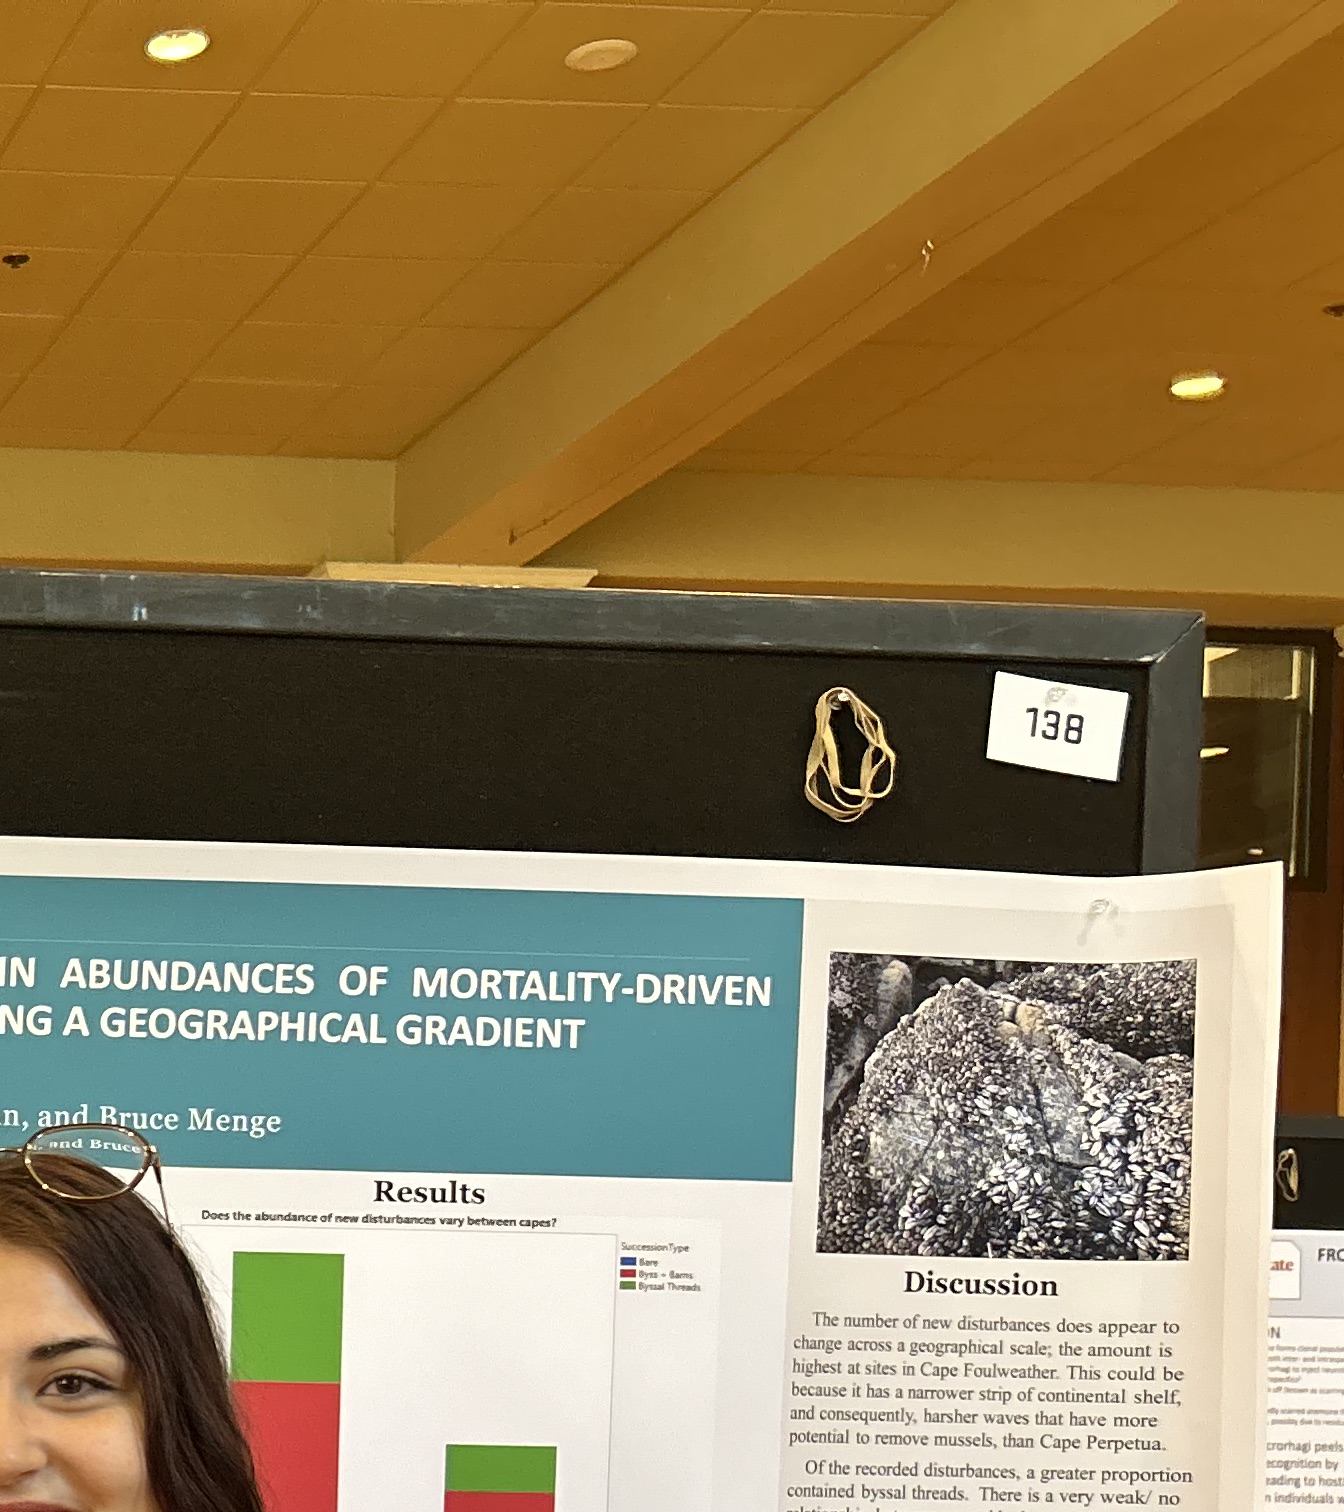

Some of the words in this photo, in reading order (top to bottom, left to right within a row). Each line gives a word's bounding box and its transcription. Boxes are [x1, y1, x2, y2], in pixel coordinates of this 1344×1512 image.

[1026, 707, 1084, 745] 138
[59, 958, 314, 995] ABUNDANCES
[339, 965, 388, 996] OF
[412, 967, 771, 1006] MORTALITY-DRIVEN
[62, 1005, 90, 1036] A
[100, 1006, 387, 1044] GEOGRAPHICAL
[396, 1014, 586, 1048] GRADIENT
[37, 1103, 88, 1127] and
[99, 1105, 179, 1130] Bruce
[187, 1107, 281, 1139] Menge
[373, 1180, 485, 1204] Results
[904, 1270, 1058, 1296] Discussion
[793, 1334, 842, 1354] change
[847, 1339, 892, 1352] across
[896, 1341, 905, 1352] a
[909, 1338, 1003, 1358] geographical
[1009, 1340, 1052, 1358] scale;
[1058, 1340, 1083, 1356] the
[1087, 1345, 1152, 1357] amount
[1159, 1342, 1172, 1358] is
